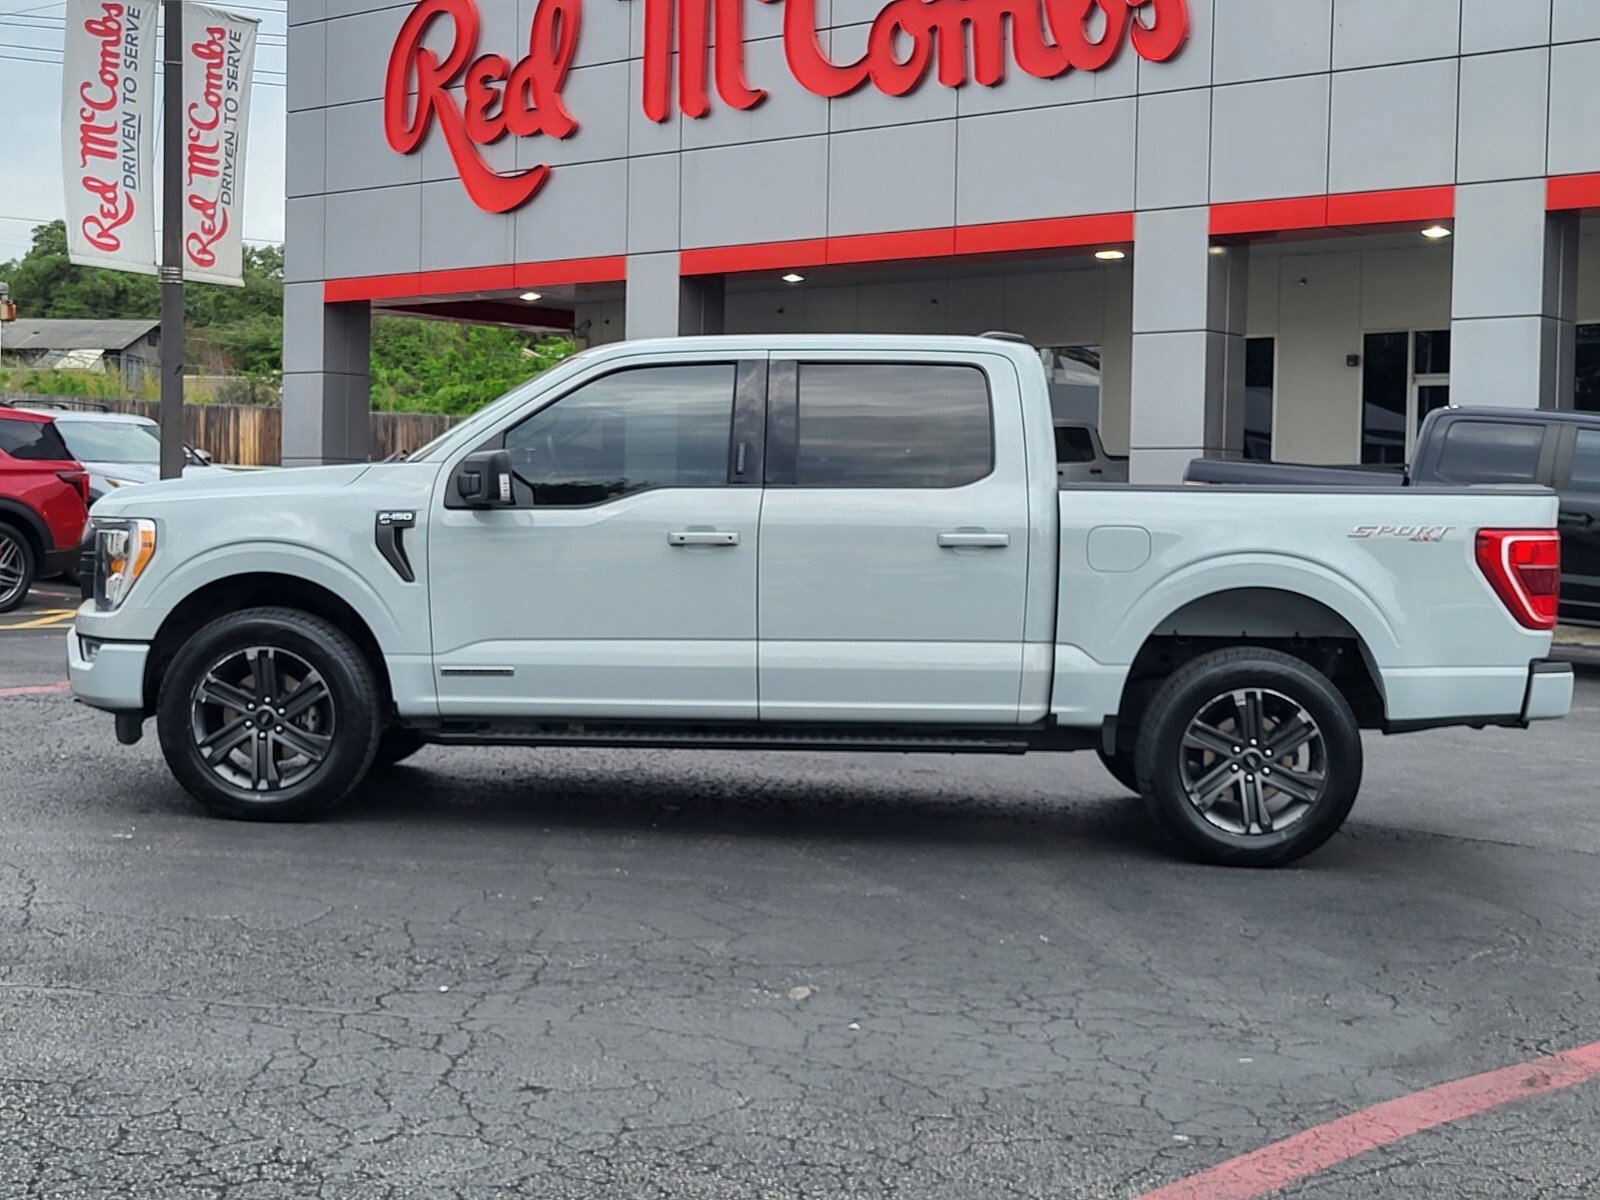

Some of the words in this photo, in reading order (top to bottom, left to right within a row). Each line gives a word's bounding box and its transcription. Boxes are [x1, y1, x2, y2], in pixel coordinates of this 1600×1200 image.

[124, 6, 141, 71] SERVE
[227, 30, 241, 92] SERVE
[80, 3, 124, 168] McCombs
[123, 77, 137, 107] TO
[188, 27, 226, 186] McCombs
[224, 97, 238, 124] TO
[384, 0, 582, 214] Red
[122, 112, 137, 190] DRIVEN
[221, 131, 236, 206] DRIVEN
[82, 176, 134, 252] Red
[186, 194, 228, 267] Red
[1347, 526, 1456, 539] SPORT
